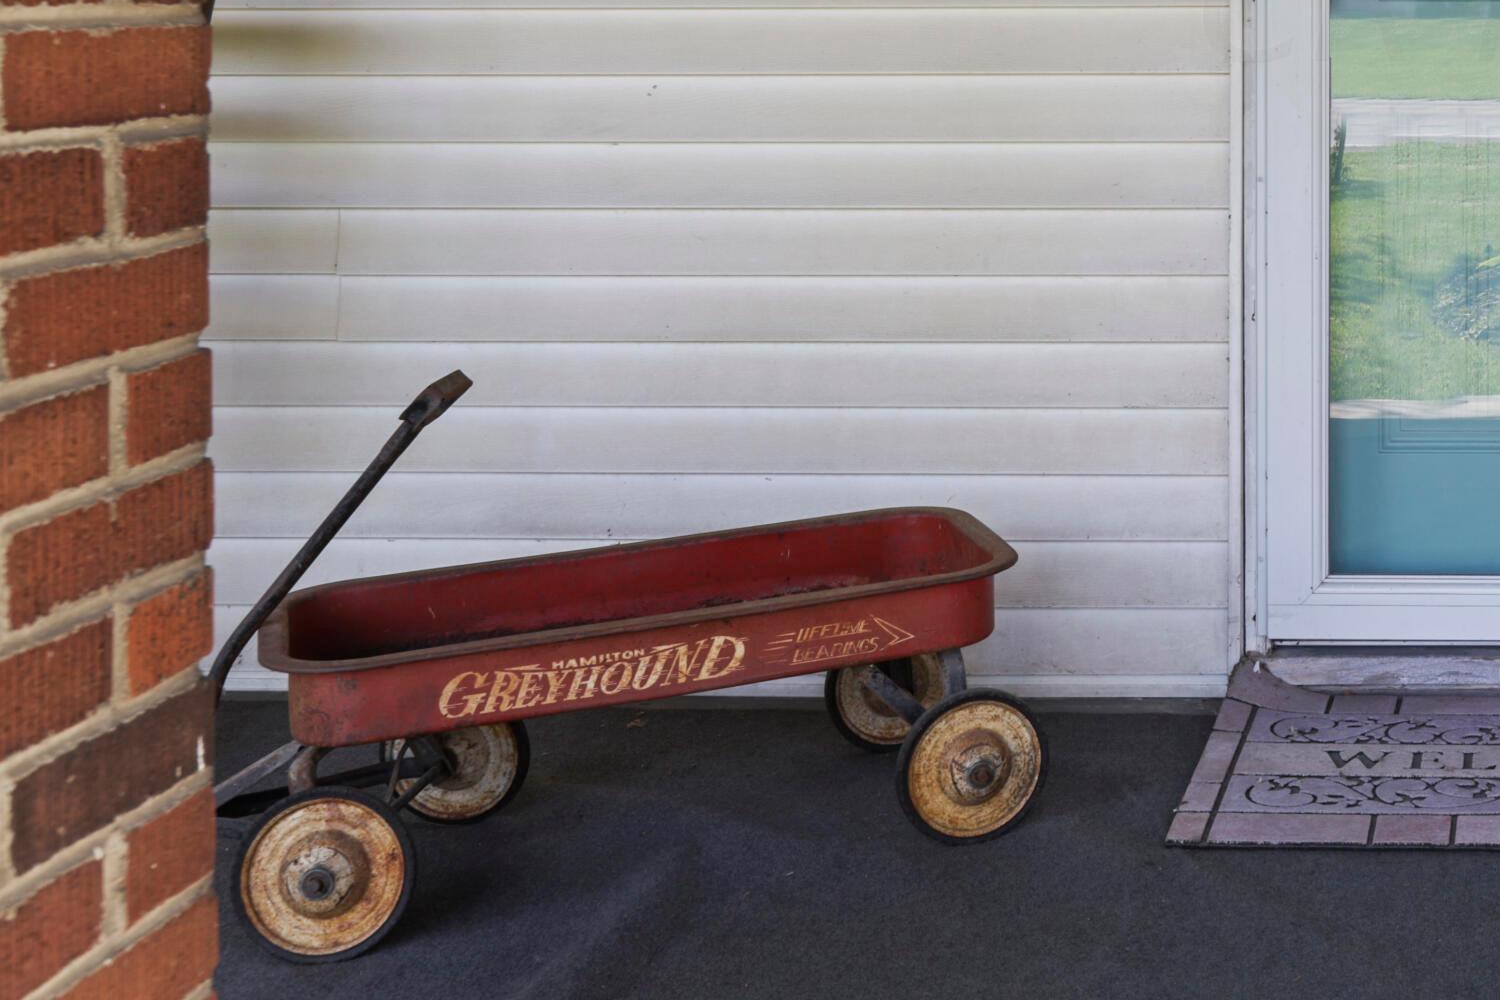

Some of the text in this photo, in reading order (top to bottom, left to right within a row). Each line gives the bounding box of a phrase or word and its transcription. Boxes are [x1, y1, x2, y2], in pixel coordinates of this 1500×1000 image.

[551, 648, 647, 670] HAMILTON
[792, 636, 880, 663] BEARINGS
[439, 635, 746, 719] GREYHOUND
